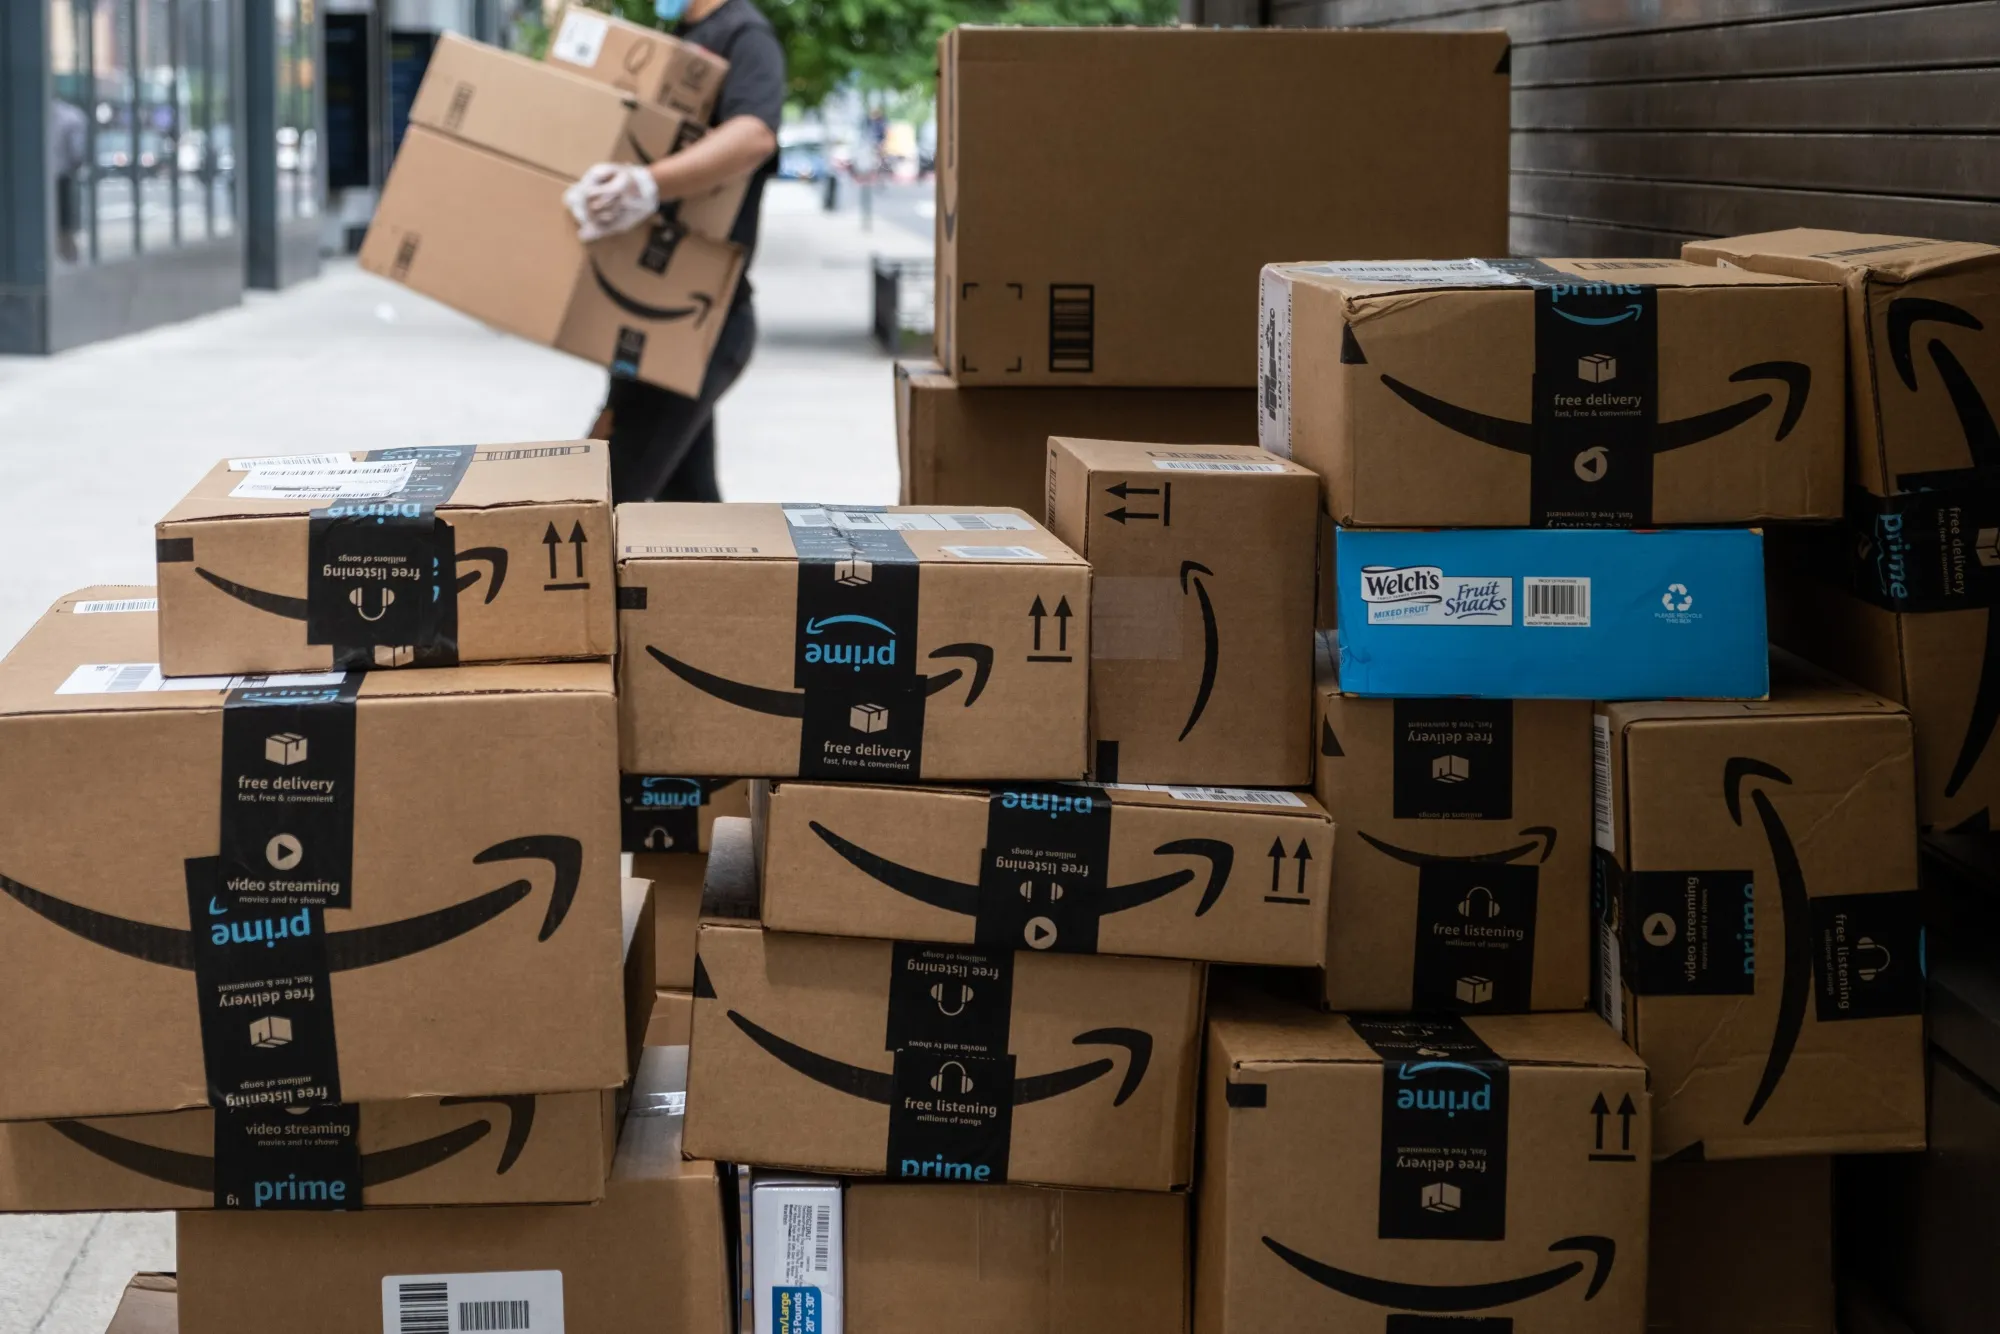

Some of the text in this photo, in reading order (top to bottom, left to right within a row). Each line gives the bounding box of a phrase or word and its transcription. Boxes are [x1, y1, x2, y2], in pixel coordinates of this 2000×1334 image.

[1554, 393, 1642, 408] free delivery
[1554, 409, 1642, 418] fast, free & convenient
[1879, 513, 1911, 599] prime
[1949, 507, 1966, 594] free delivery
[338, 555, 407, 564] millions of songs
[322, 564, 421, 580] free listening
[1364, 570, 1440, 597] Welch's
[1457, 580, 1500, 601] Fruit
[1374, 609, 1402, 620] MIXED
[1404, 604, 1430, 616] FRUIT
[1444, 595, 1507, 616] Snacks
[804, 640, 896, 672] prime
[1452, 721, 1458, 729] &
[1407, 730, 1493, 744] free delivery
[823, 740, 911, 760] free delivery
[823, 756, 910, 770] fast, free & convenient
[238, 776, 334, 794] free delivery
[238, 793, 334, 803] fast, free & convenient
[1011, 848, 1077, 860] millions of songs
[996, 856, 1089, 878] free listening
[227, 878, 340, 896] video streaming
[239, 896, 267, 904] movies
[270, 896, 287, 904] and
[300, 896, 326, 904] shows
[211, 907, 310, 948] prime
[1433, 922, 1524, 941] free listening
[1684, 876, 1700, 982] video streaming
[1445, 938, 1476, 947] millions
[1488, 942, 1509, 950] songs
[922, 950, 987, 964] millions of songs
[1836, 913, 1852, 1010] free listening
[906, 958, 999, 980] free listening
[218, 976, 313, 992] fast, free & convenient
[219, 988, 315, 1008] free delivery
[908, 1040, 932, 1048] shows
[944, 1042, 959, 1050] and
[960, 1044, 987, 1052] movies
[240, 1076, 312, 1090] millions of songs
[224, 1086, 328, 1108] free listening
[1396, 1084, 1491, 1118] prime
[904, 1097, 997, 1118] free listening
[245, 1121, 350, 1136] video streaming
[916, 1114, 982, 1126] millions of songs
[1397, 1146, 1488, 1156] fast, free & convenient
[901, 1154, 991, 1182] prime
[1396, 1156, 1486, 1173] free delivery
[254, 1173, 346, 1208] prime
[793, 1292, 802, 1326] Pounds
